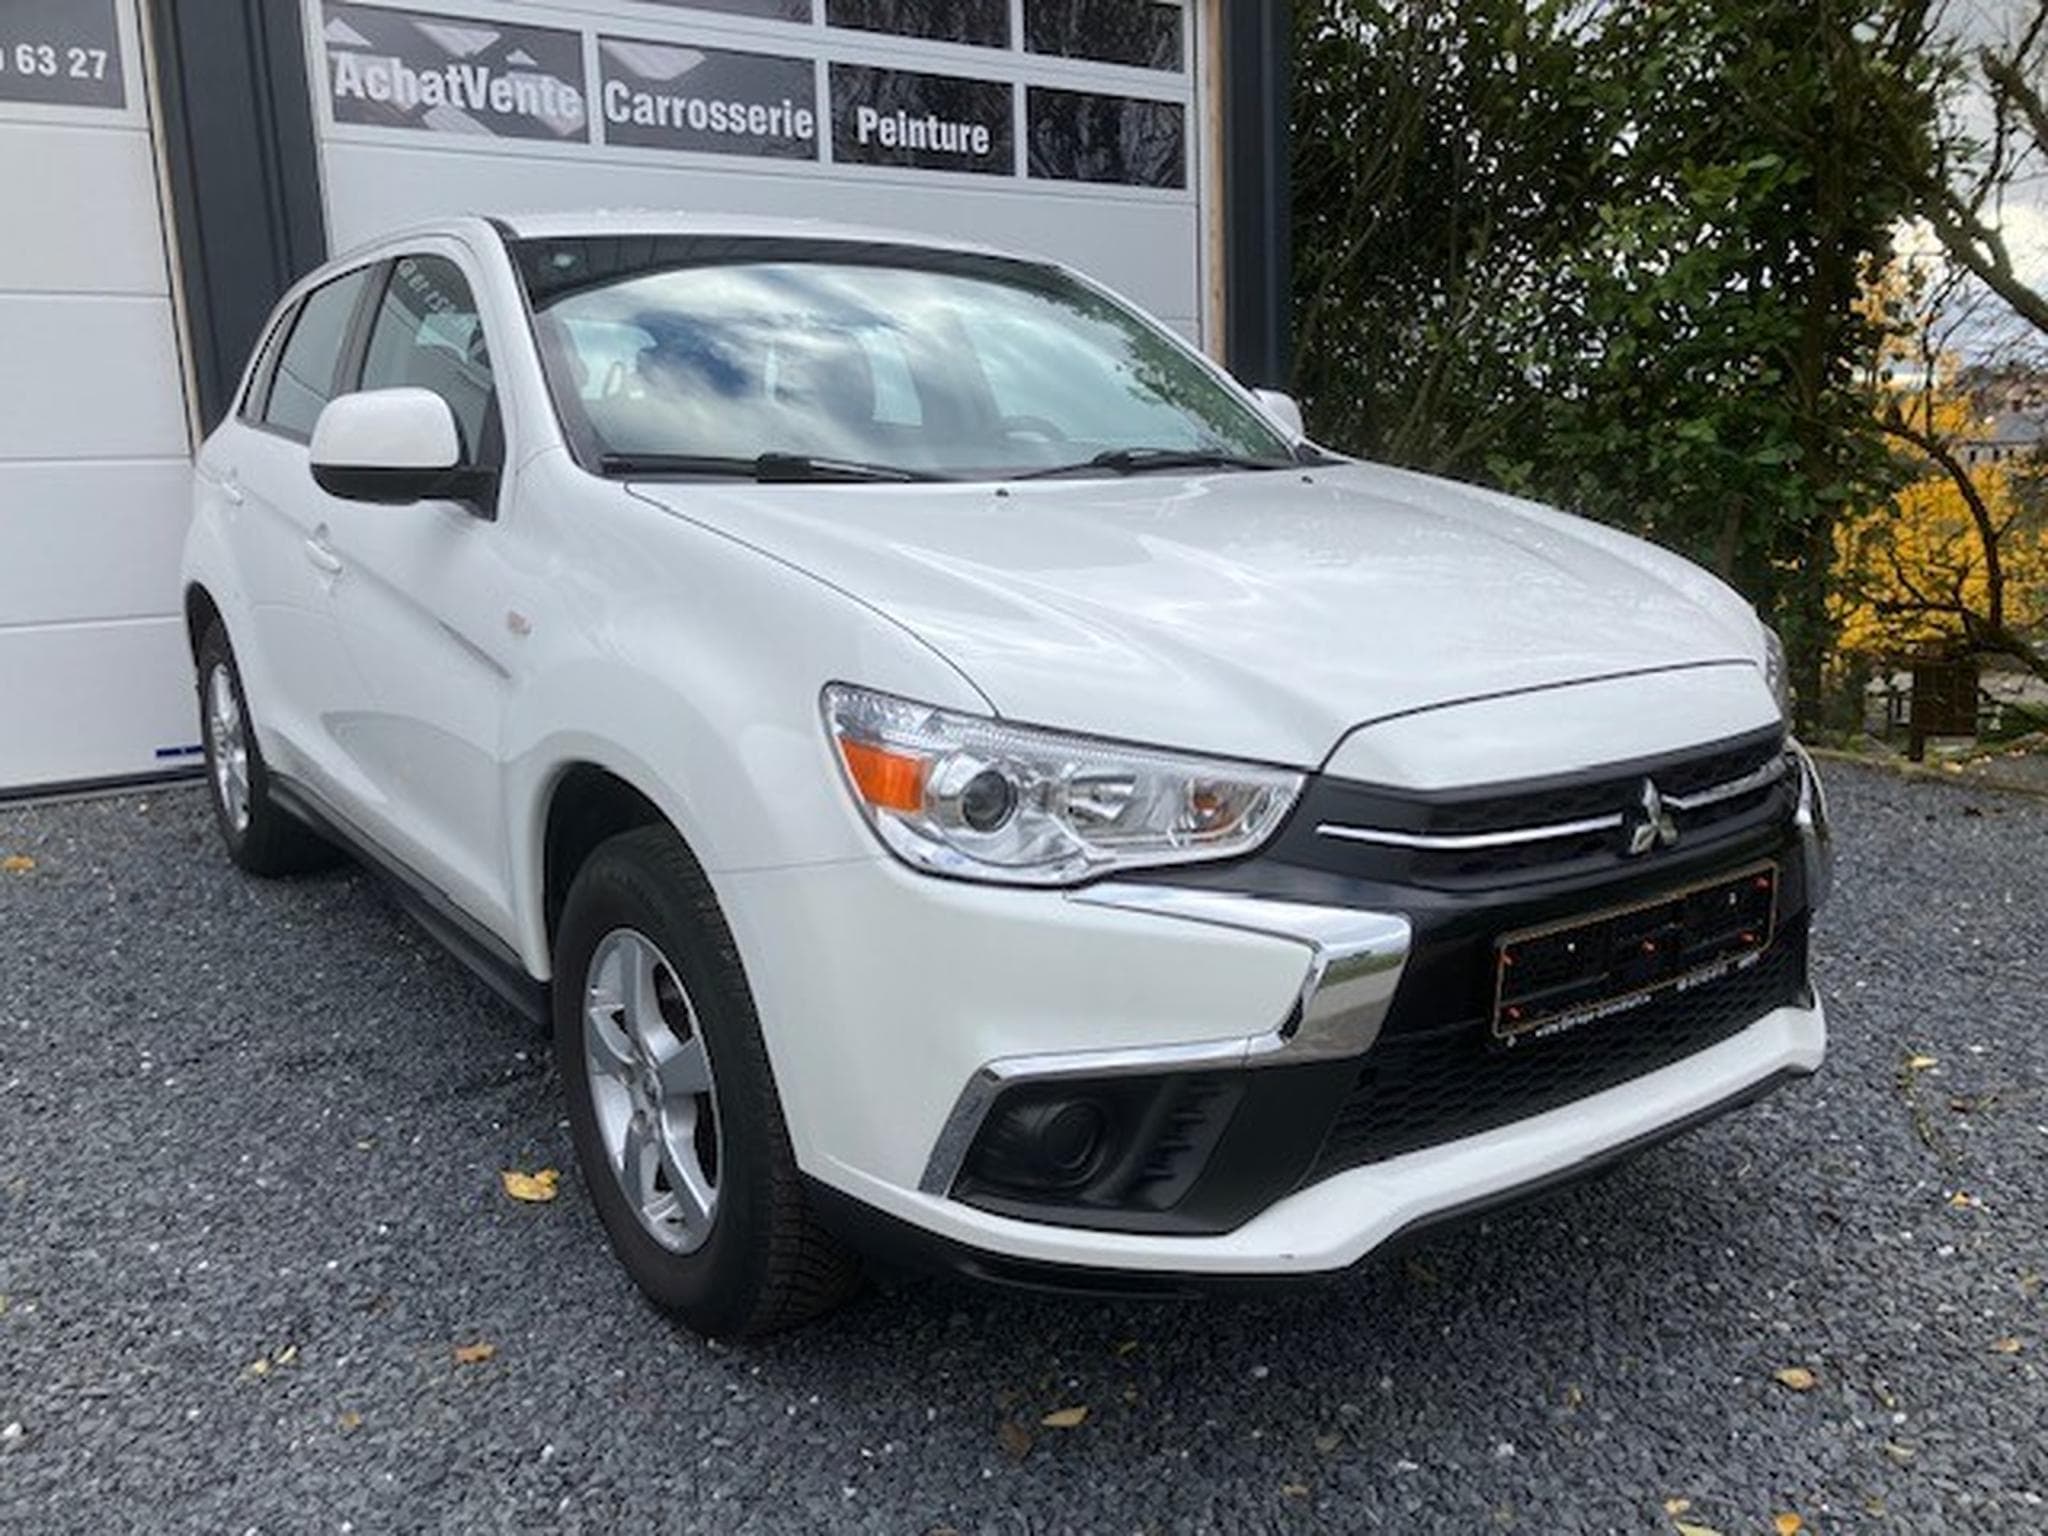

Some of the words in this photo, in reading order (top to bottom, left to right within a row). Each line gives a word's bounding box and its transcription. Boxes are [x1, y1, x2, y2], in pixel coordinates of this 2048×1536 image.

[15, 43, 58, 76] 63
[67, 47, 107, 80] 27
[604, 79, 814, 139] Carrosserie
[857, 105, 990, 154] Peinture
